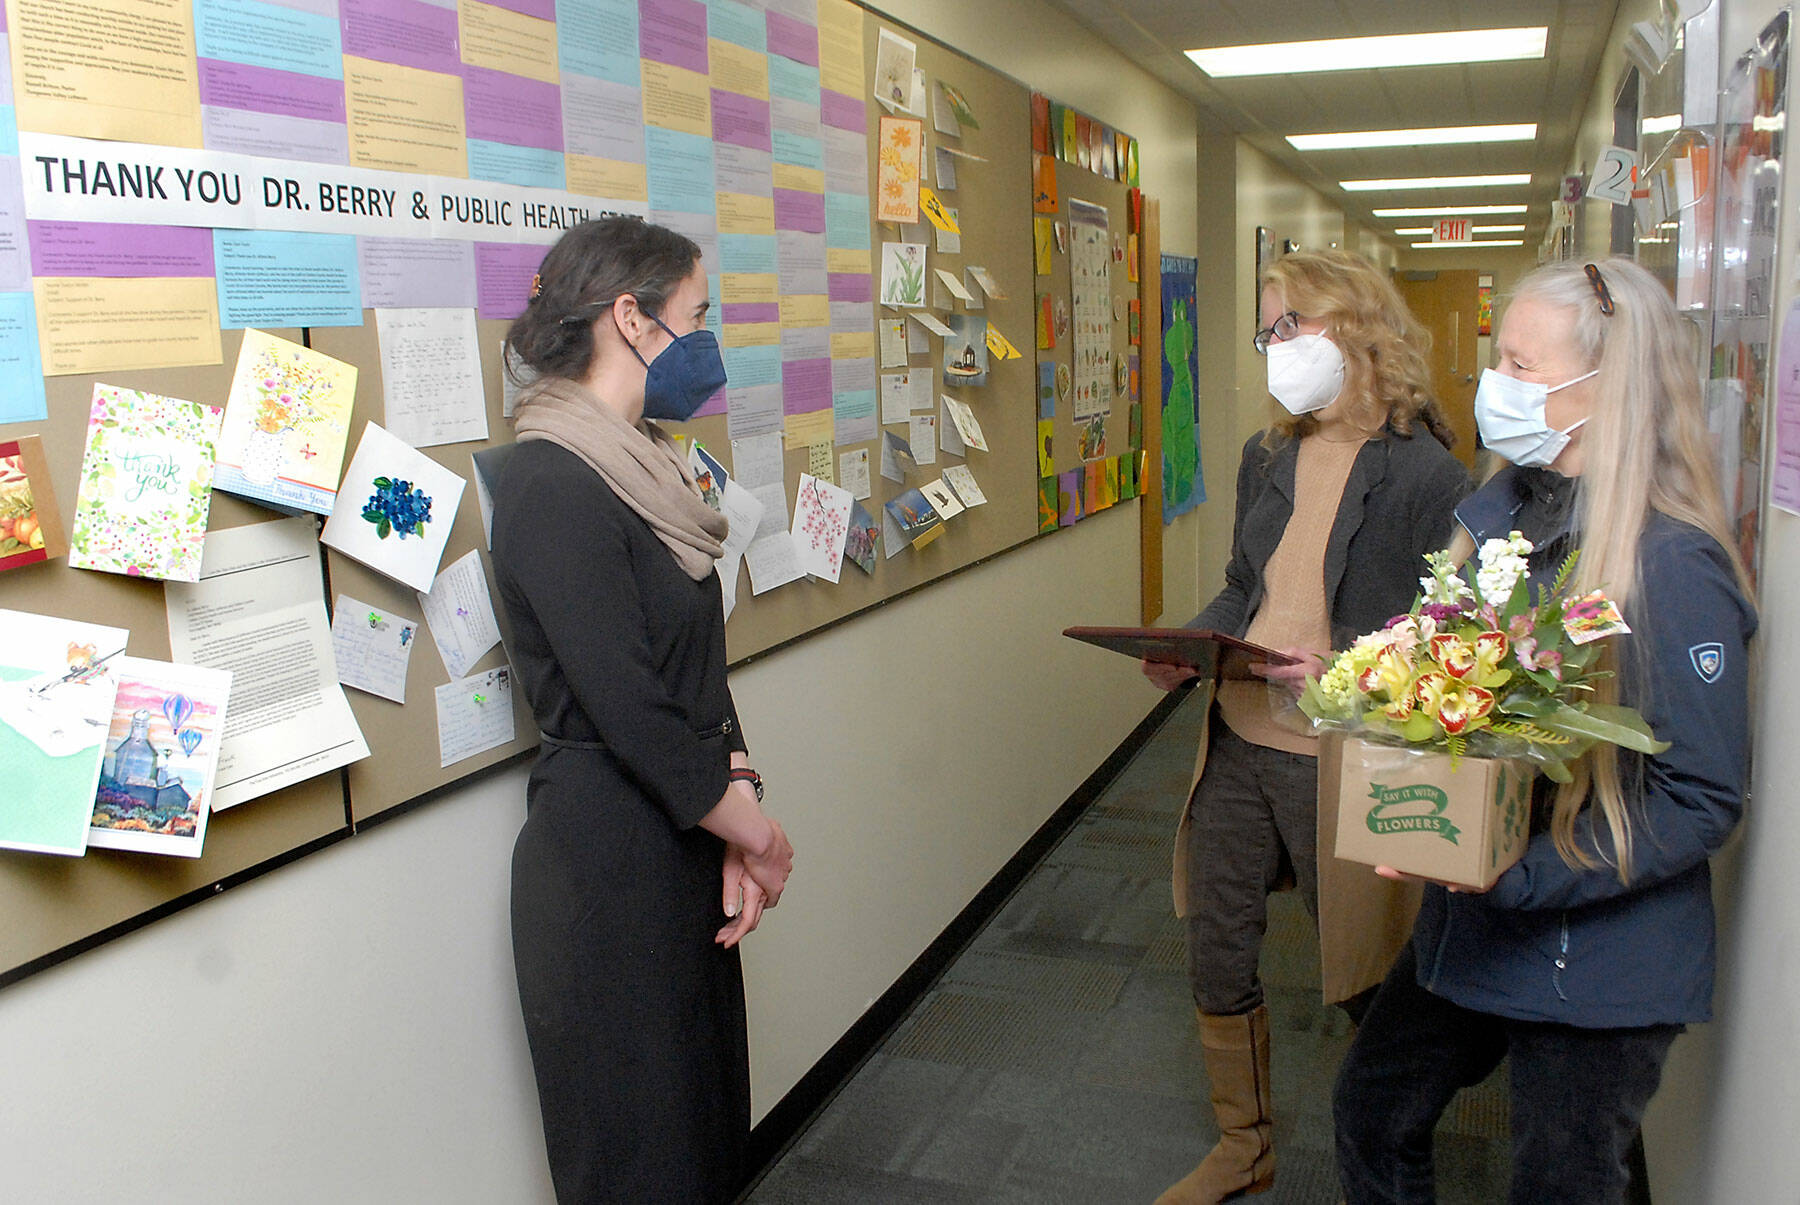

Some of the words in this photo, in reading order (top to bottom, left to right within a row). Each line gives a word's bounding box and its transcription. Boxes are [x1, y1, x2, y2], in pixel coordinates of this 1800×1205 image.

[1593, 150, 1634, 201] 2
[35, 155, 168, 200] THANK
[174, 167, 241, 206] YOU
[263, 176, 310, 211] DR.
[319, 182, 396, 218] BERRY
[412, 190, 430, 220] &
[440, 194, 513, 226] PUBLIC
[522, 202, 589, 230] HEALTH
[1564, 177, 1582, 203] 3
[883, 201, 912, 217] hello
[1440, 219, 1467, 241] EXIT
[115, 448, 181, 485] thank
[125, 473, 178, 503] you
[274, 483, 305, 501] Thank
[310, 491, 329, 507] You
[1383, 791, 1401, 802] SAY
[1401, 789, 1411, 799] IT
[1414, 788, 1439, 800] WITH
[1377, 818, 1440, 832] FLOWERS
